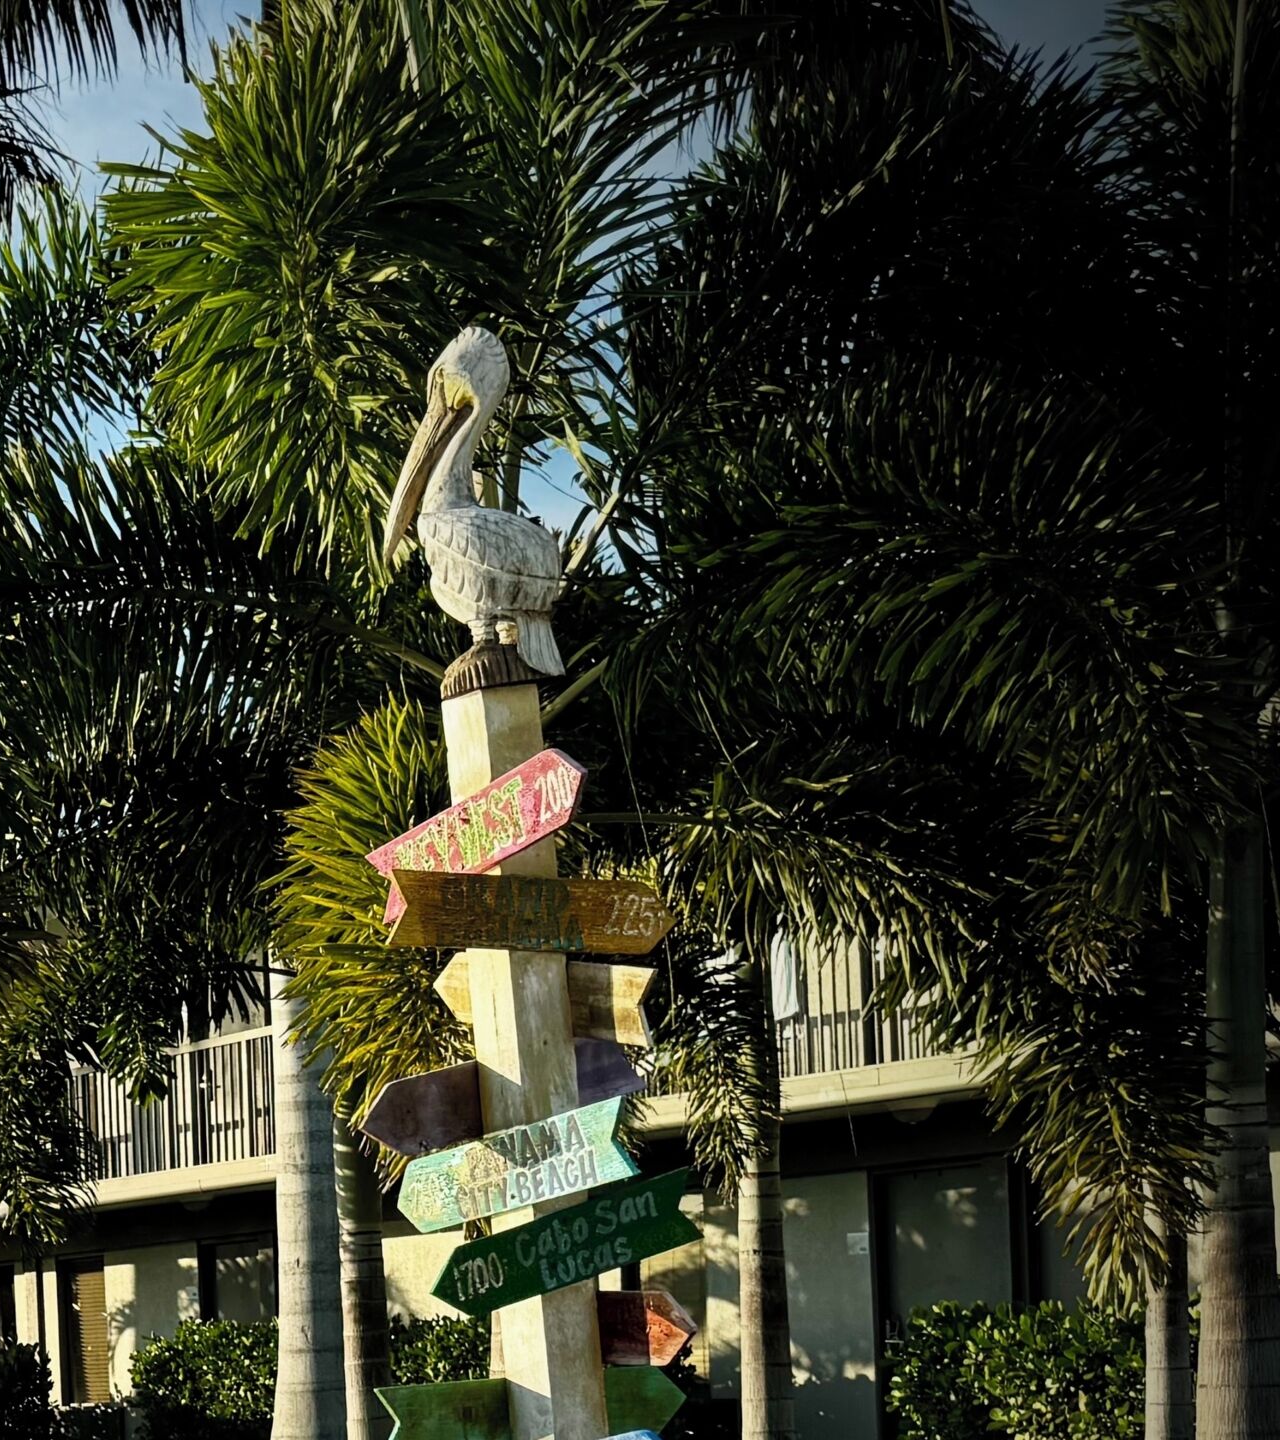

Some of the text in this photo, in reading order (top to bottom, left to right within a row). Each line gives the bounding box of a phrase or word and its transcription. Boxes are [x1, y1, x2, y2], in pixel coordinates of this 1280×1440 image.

[451, 774, 528, 869] WEST
[534, 764, 574, 824] 200
[456, 1175, 509, 1221] CITY
[514, 1147, 601, 1205] BEACH
[453, 1190, 658, 1302] 1700 Cabo San
